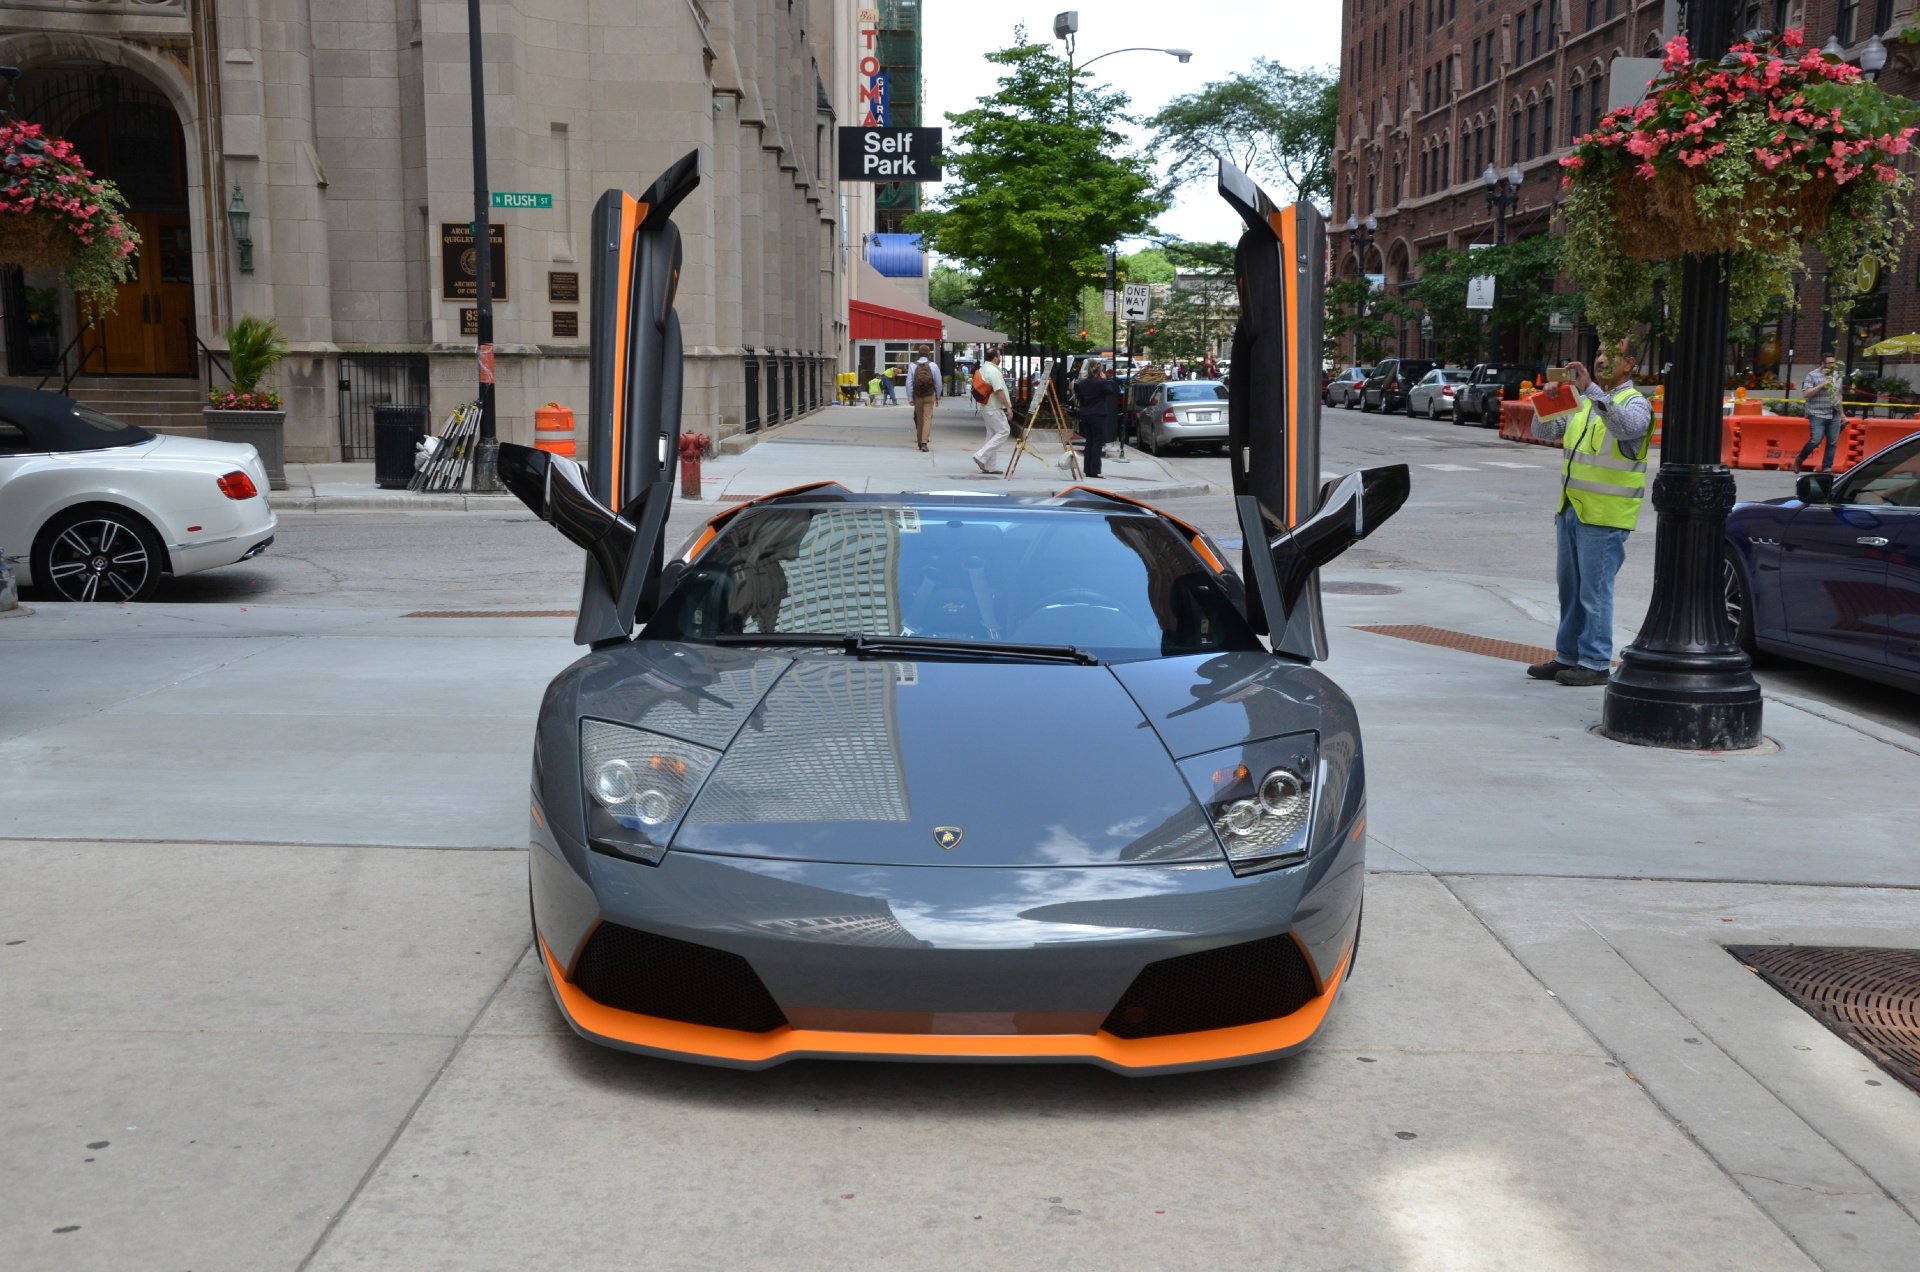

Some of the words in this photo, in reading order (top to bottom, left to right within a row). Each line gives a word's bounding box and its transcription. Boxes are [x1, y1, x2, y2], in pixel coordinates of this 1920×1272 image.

[864, 132, 913, 153] Self
[864, 155, 916, 175] Park
[495, 196, 501, 204] N
[504, 194, 537, 206] RUSH
[540, 197, 549, 205] ST
[1127, 286, 1146, 296] ONE
[1126, 297, 1146, 306] WAY
